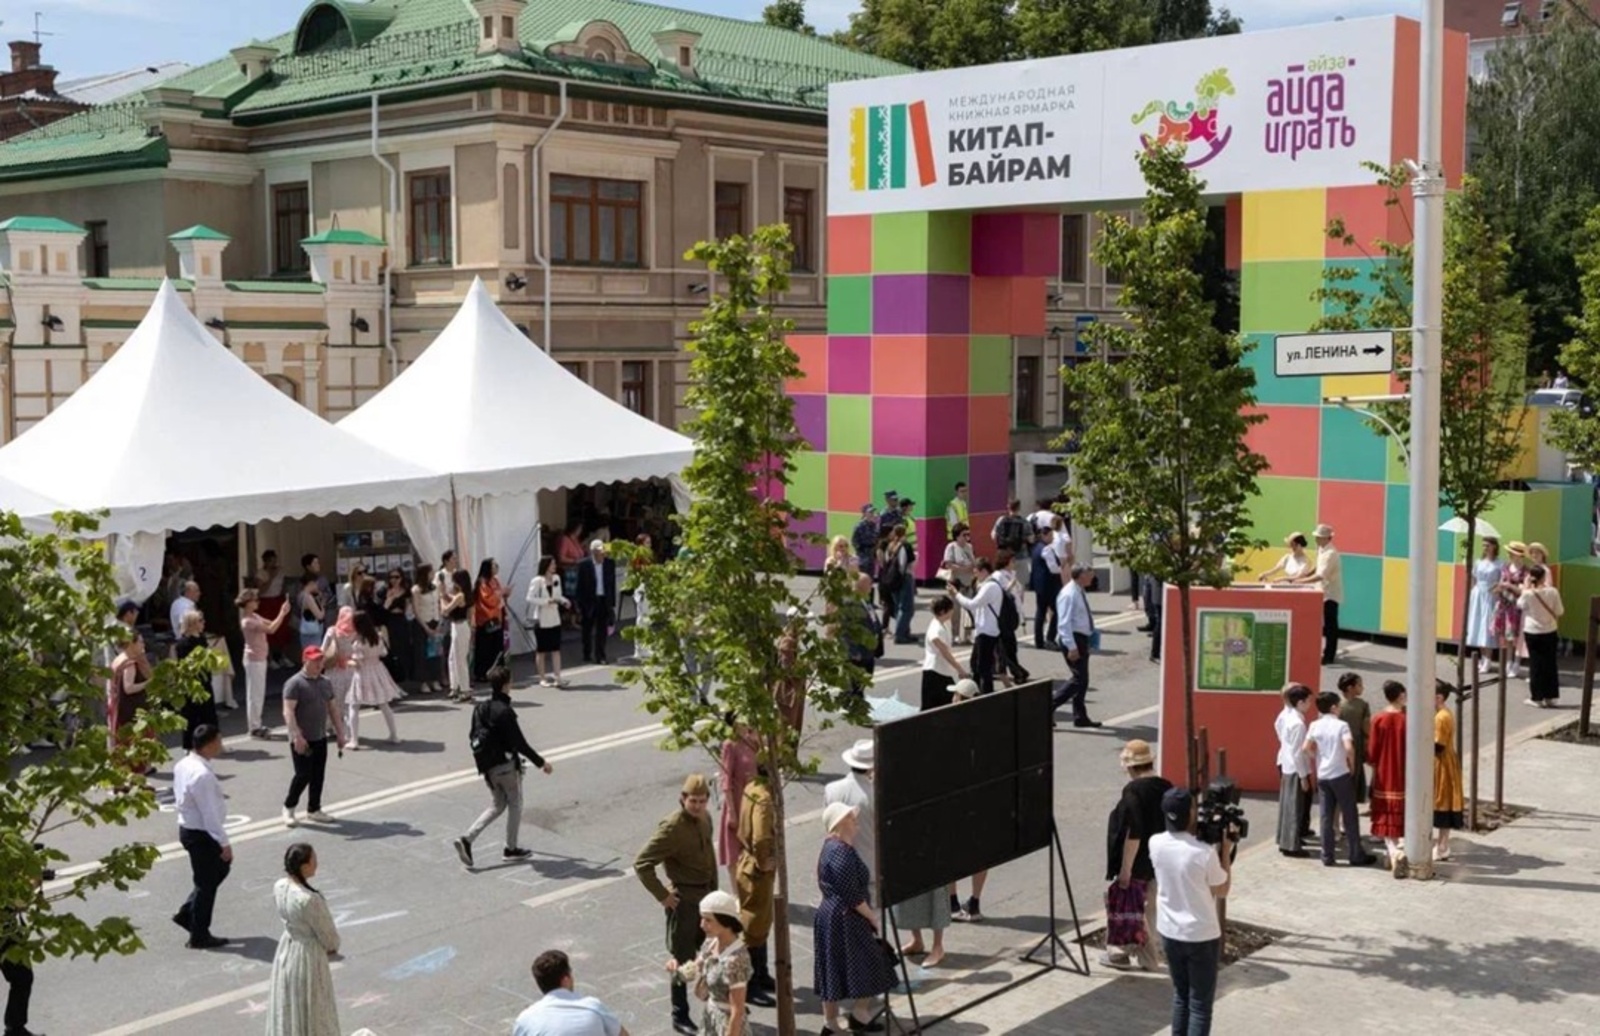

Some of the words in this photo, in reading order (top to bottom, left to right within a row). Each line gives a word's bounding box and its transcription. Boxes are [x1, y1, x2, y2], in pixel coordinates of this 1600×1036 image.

[949, 84, 1075, 108] МЕЖДУНАРОДНАЯ
[949, 105, 1010, 121] КНИЖНАЯ
[1012, 99, 1076, 116] ЯРМАРКА
[948, 121, 1055, 154] КИТАП-
[1265, 116, 1356, 161] играть
[948, 153, 1071, 187] БАЙРАМ
[1304, 345, 1358, 359] ЛЕНИНА
[139, 566, 147, 582] 2
